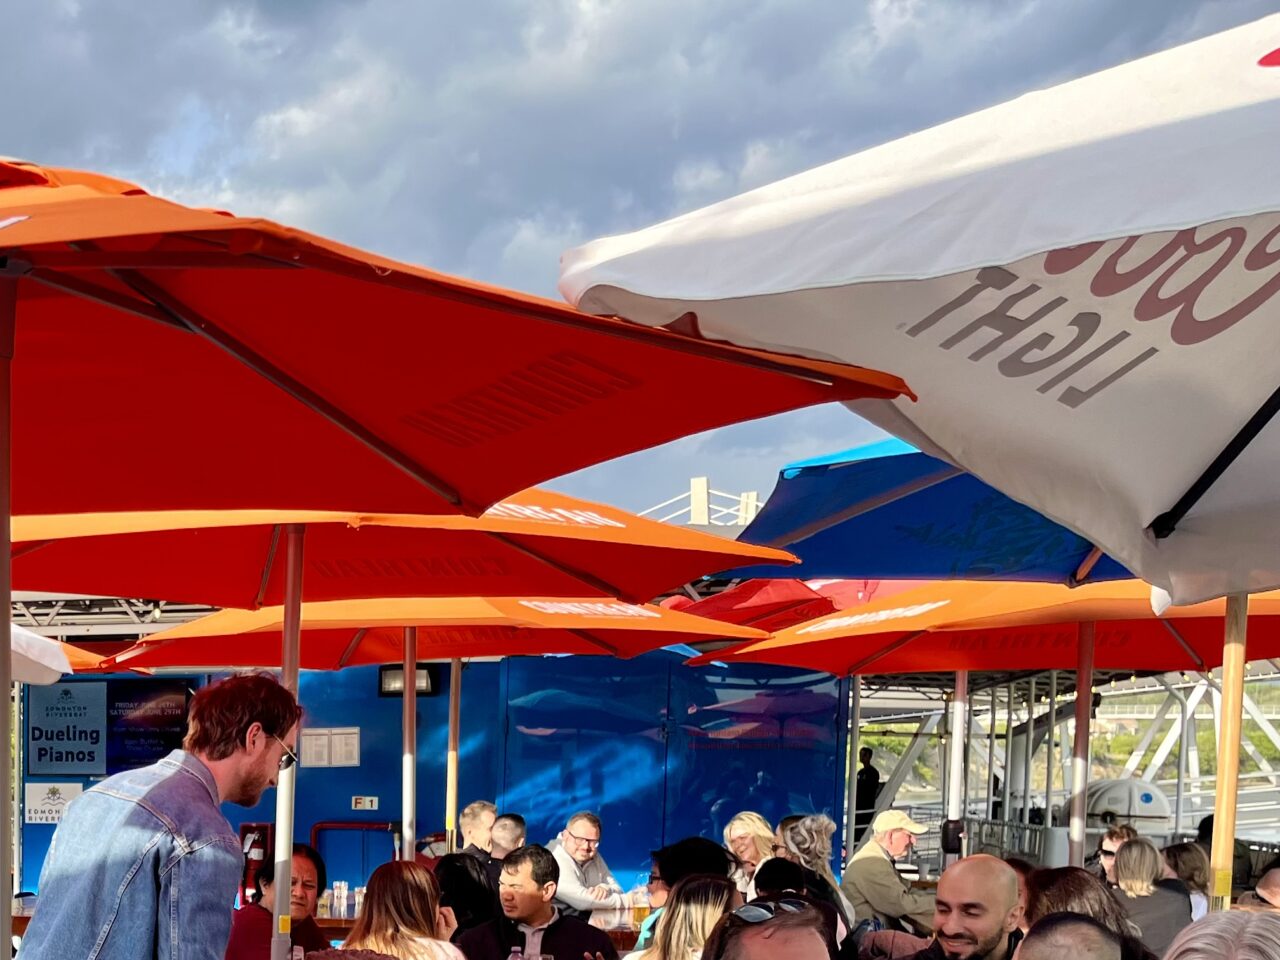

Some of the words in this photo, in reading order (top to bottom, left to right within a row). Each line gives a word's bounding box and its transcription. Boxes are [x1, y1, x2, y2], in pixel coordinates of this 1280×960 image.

[31, 725, 100, 745] Dueling
[37, 746, 96, 763] Pianos
[354, 797, 362, 808] F
[369, 799, 374, 808] 1
